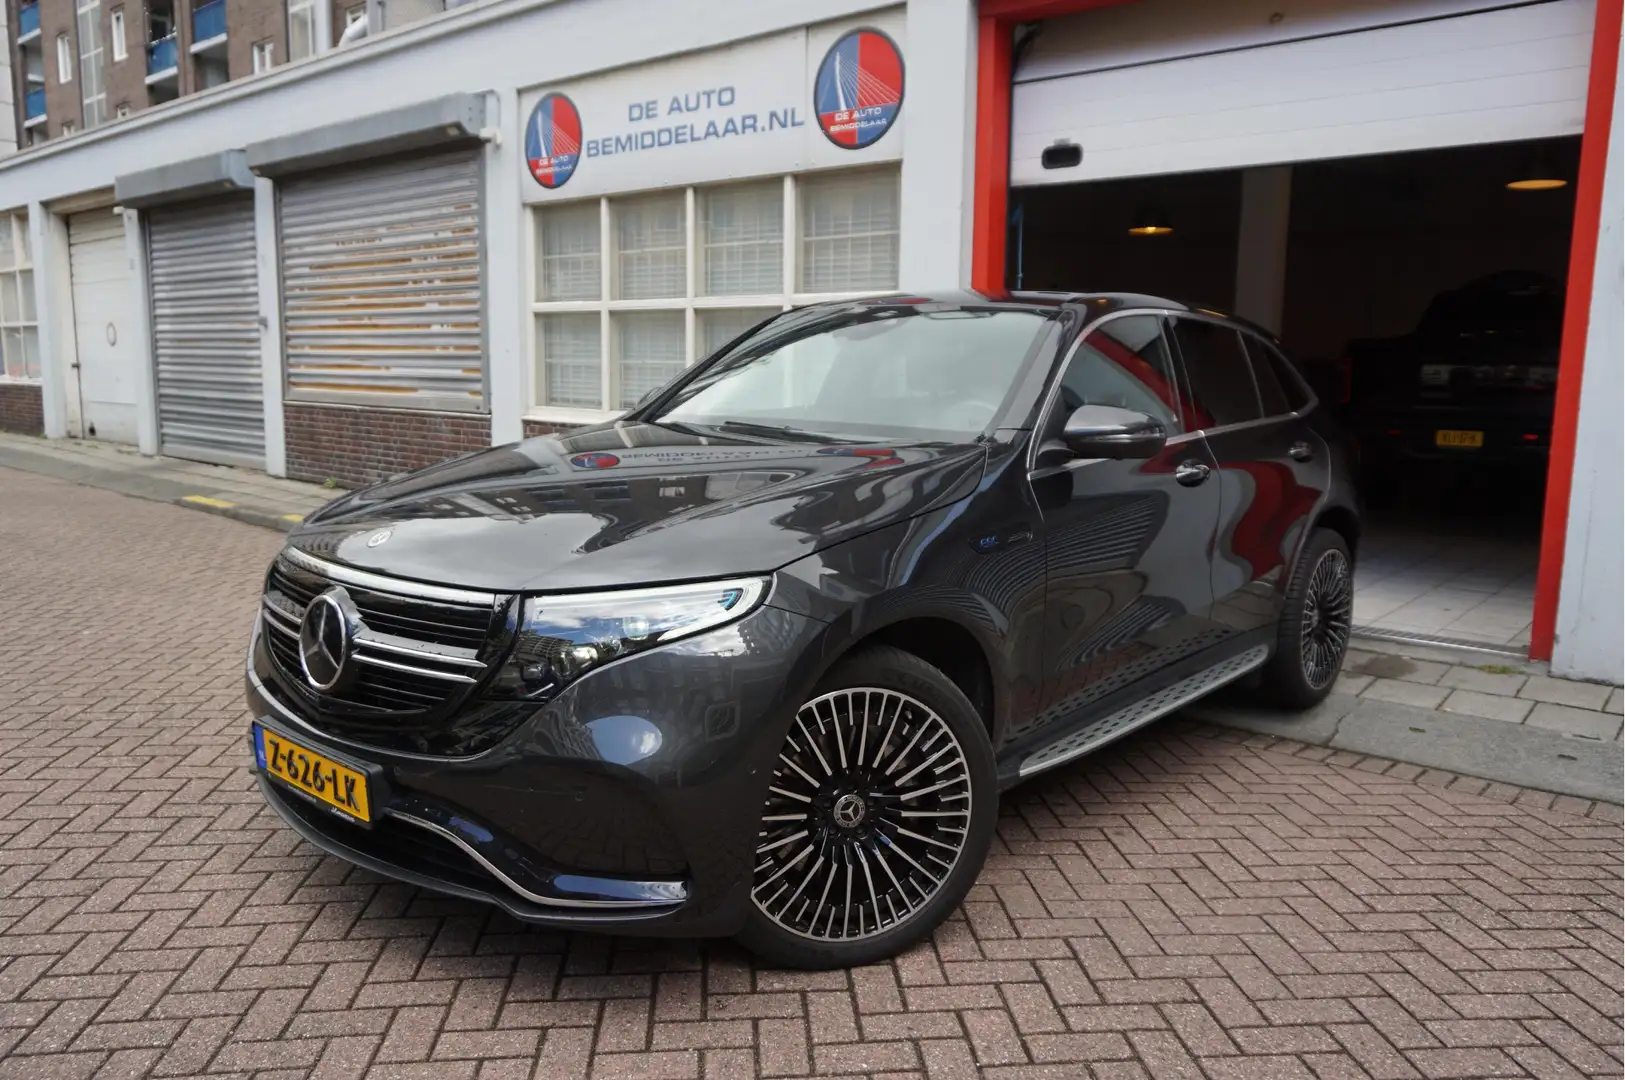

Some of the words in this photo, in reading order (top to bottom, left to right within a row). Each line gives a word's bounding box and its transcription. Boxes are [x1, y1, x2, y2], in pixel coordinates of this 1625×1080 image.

[628, 100, 658, 122] DE
[667, 86, 736, 116] AUTO
[835, 111, 850, 121] DE
[853, 107, 882, 120] AUTO
[586, 107, 805, 158] BEMIDDELAAR.NL
[830, 118, 888, 132] BEMIDDELAAR
[268, 739, 361, 812] Z-626-LK
